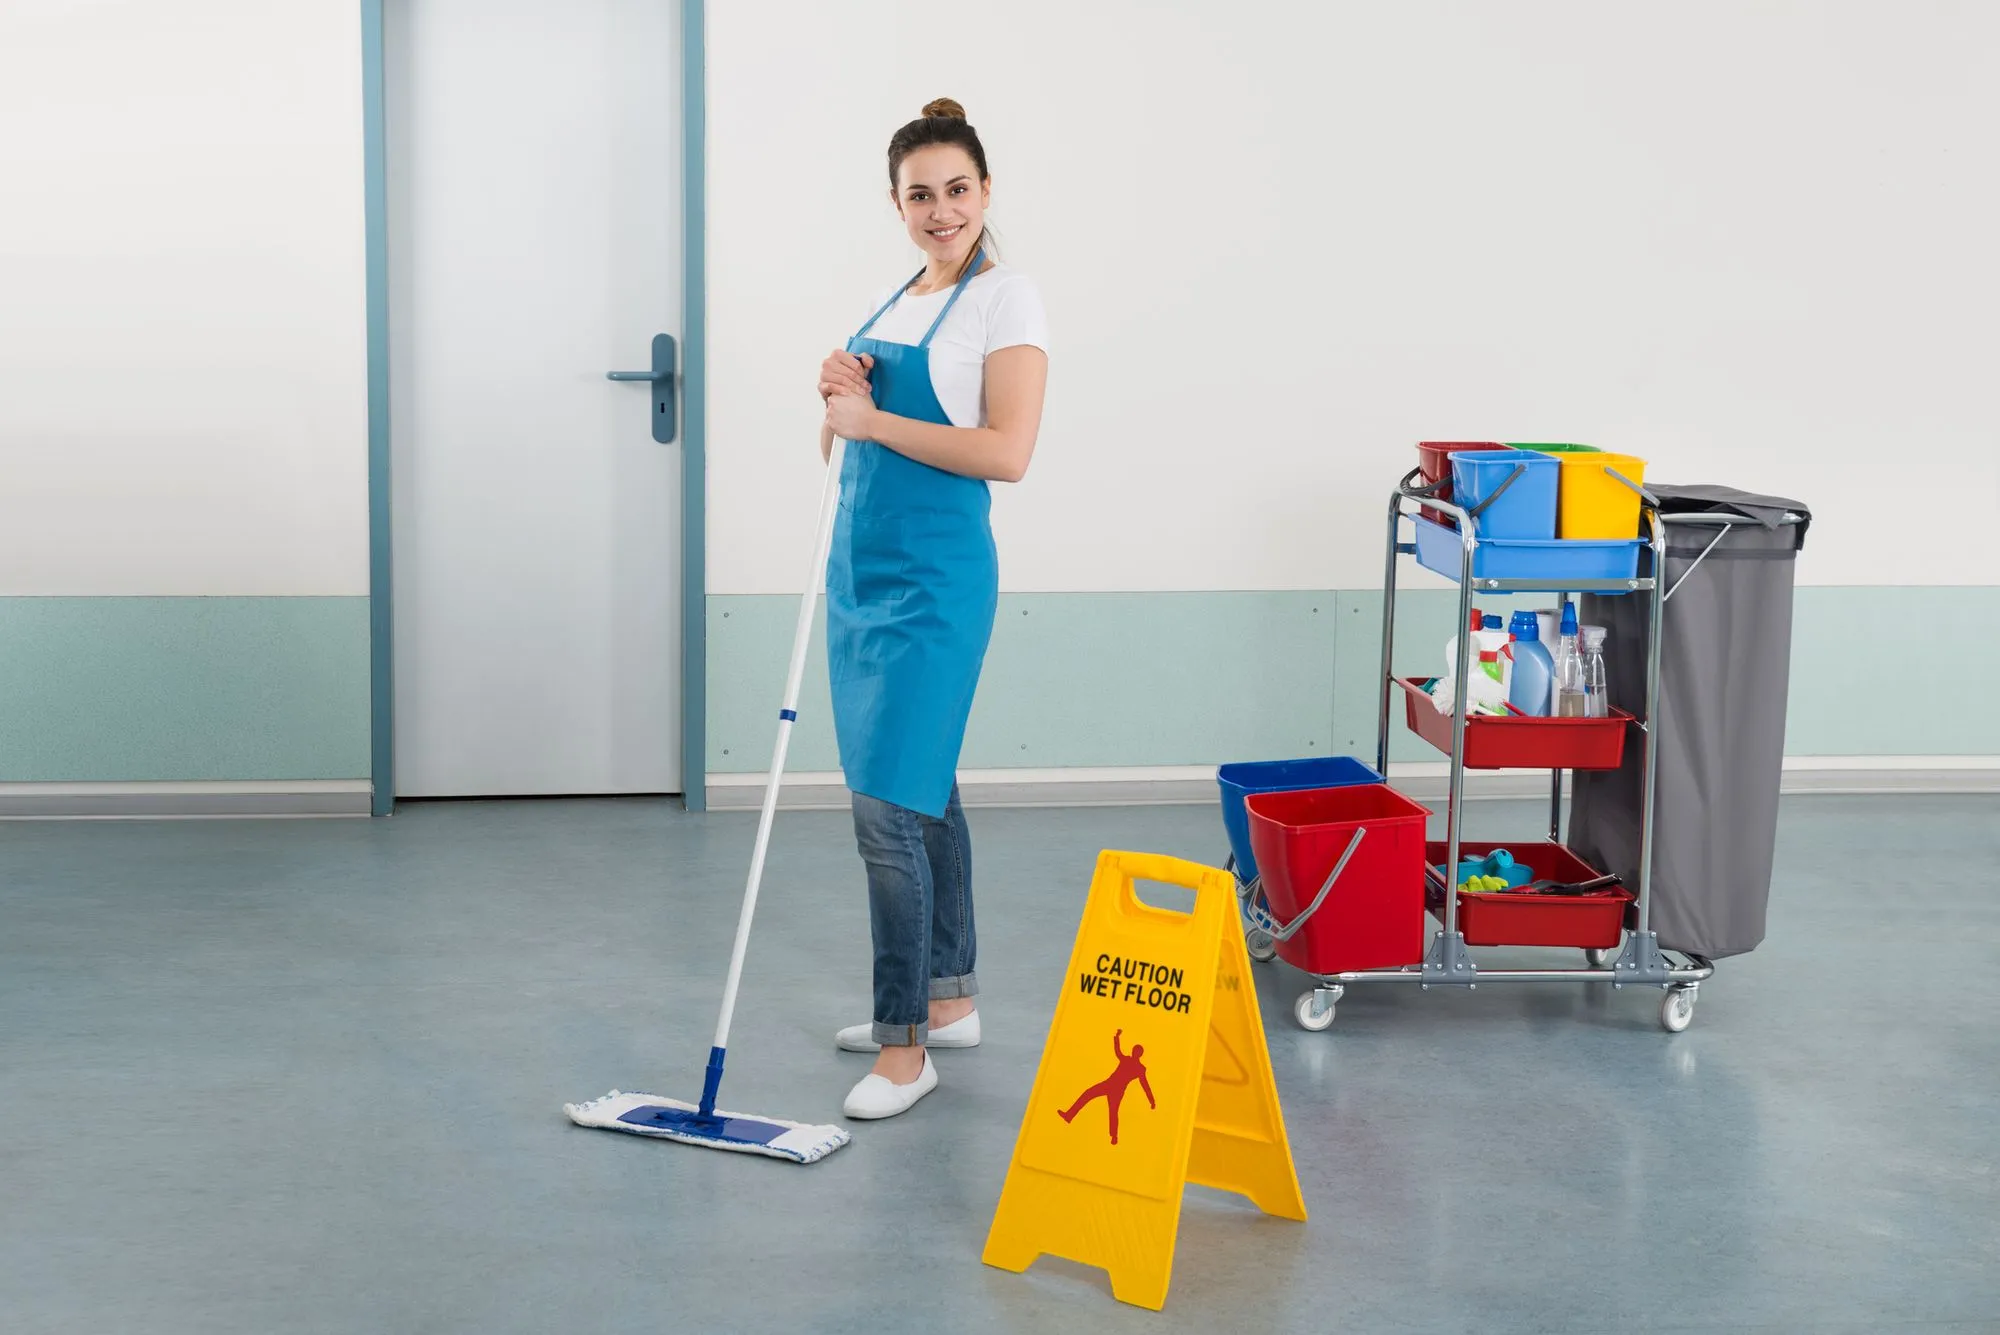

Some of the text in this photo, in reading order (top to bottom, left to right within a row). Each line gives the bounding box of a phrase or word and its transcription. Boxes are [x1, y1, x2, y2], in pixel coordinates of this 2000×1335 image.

[1096, 953, 1184, 988] CAUTION
[1080, 973, 1122, 999] WET
[1124, 982, 1192, 1014] FLOOR
